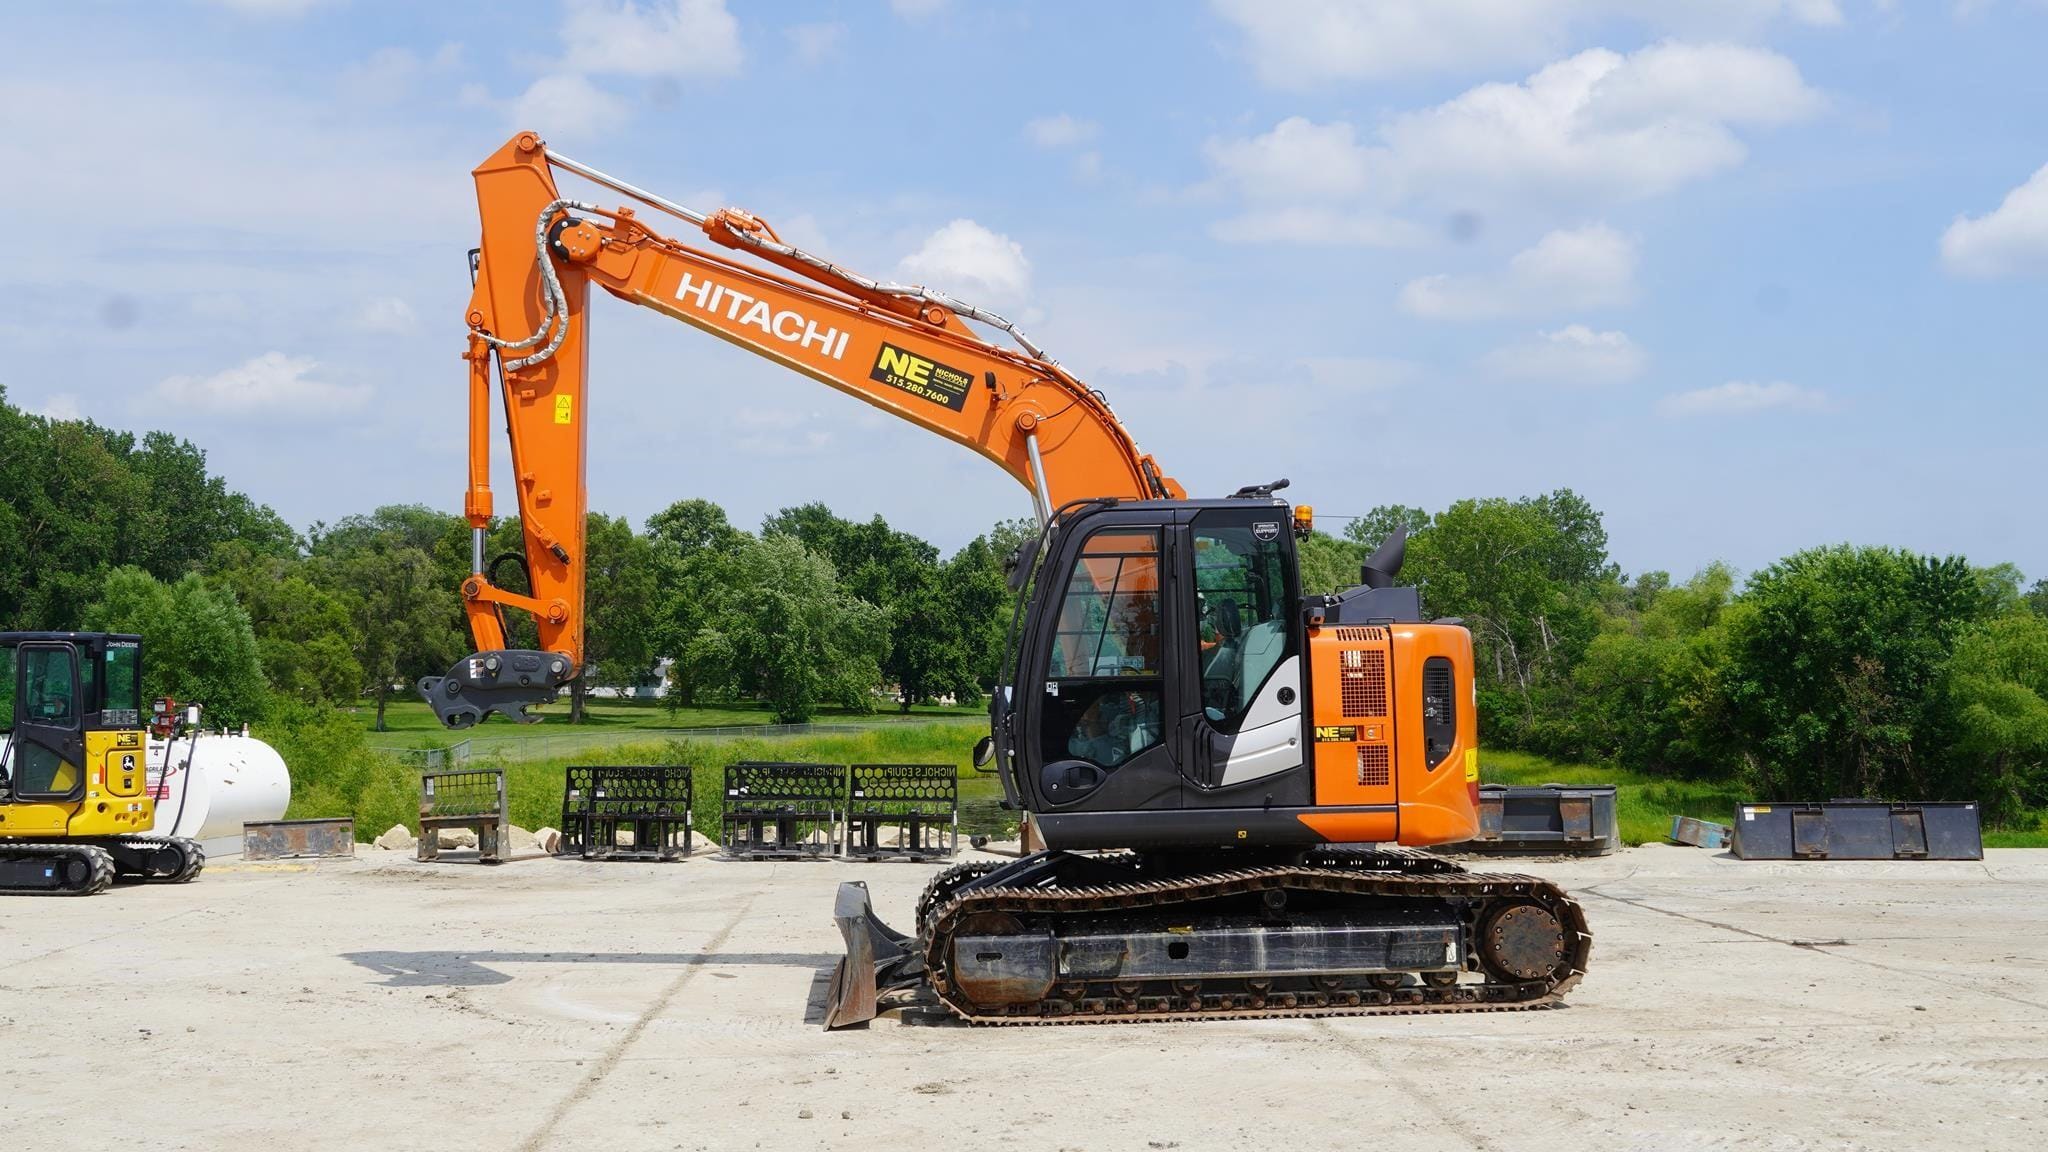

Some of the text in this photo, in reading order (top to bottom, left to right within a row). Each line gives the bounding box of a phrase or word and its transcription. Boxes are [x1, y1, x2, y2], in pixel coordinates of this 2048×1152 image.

[674, 271, 850, 360] HITACHI
[878, 346, 934, 386] NE
[935, 367, 969, 384] NICHOLS
[885, 374, 949, 404] 515.280.7600
[118, 734, 131, 743] NE
[1315, 727, 1340, 738] NE
